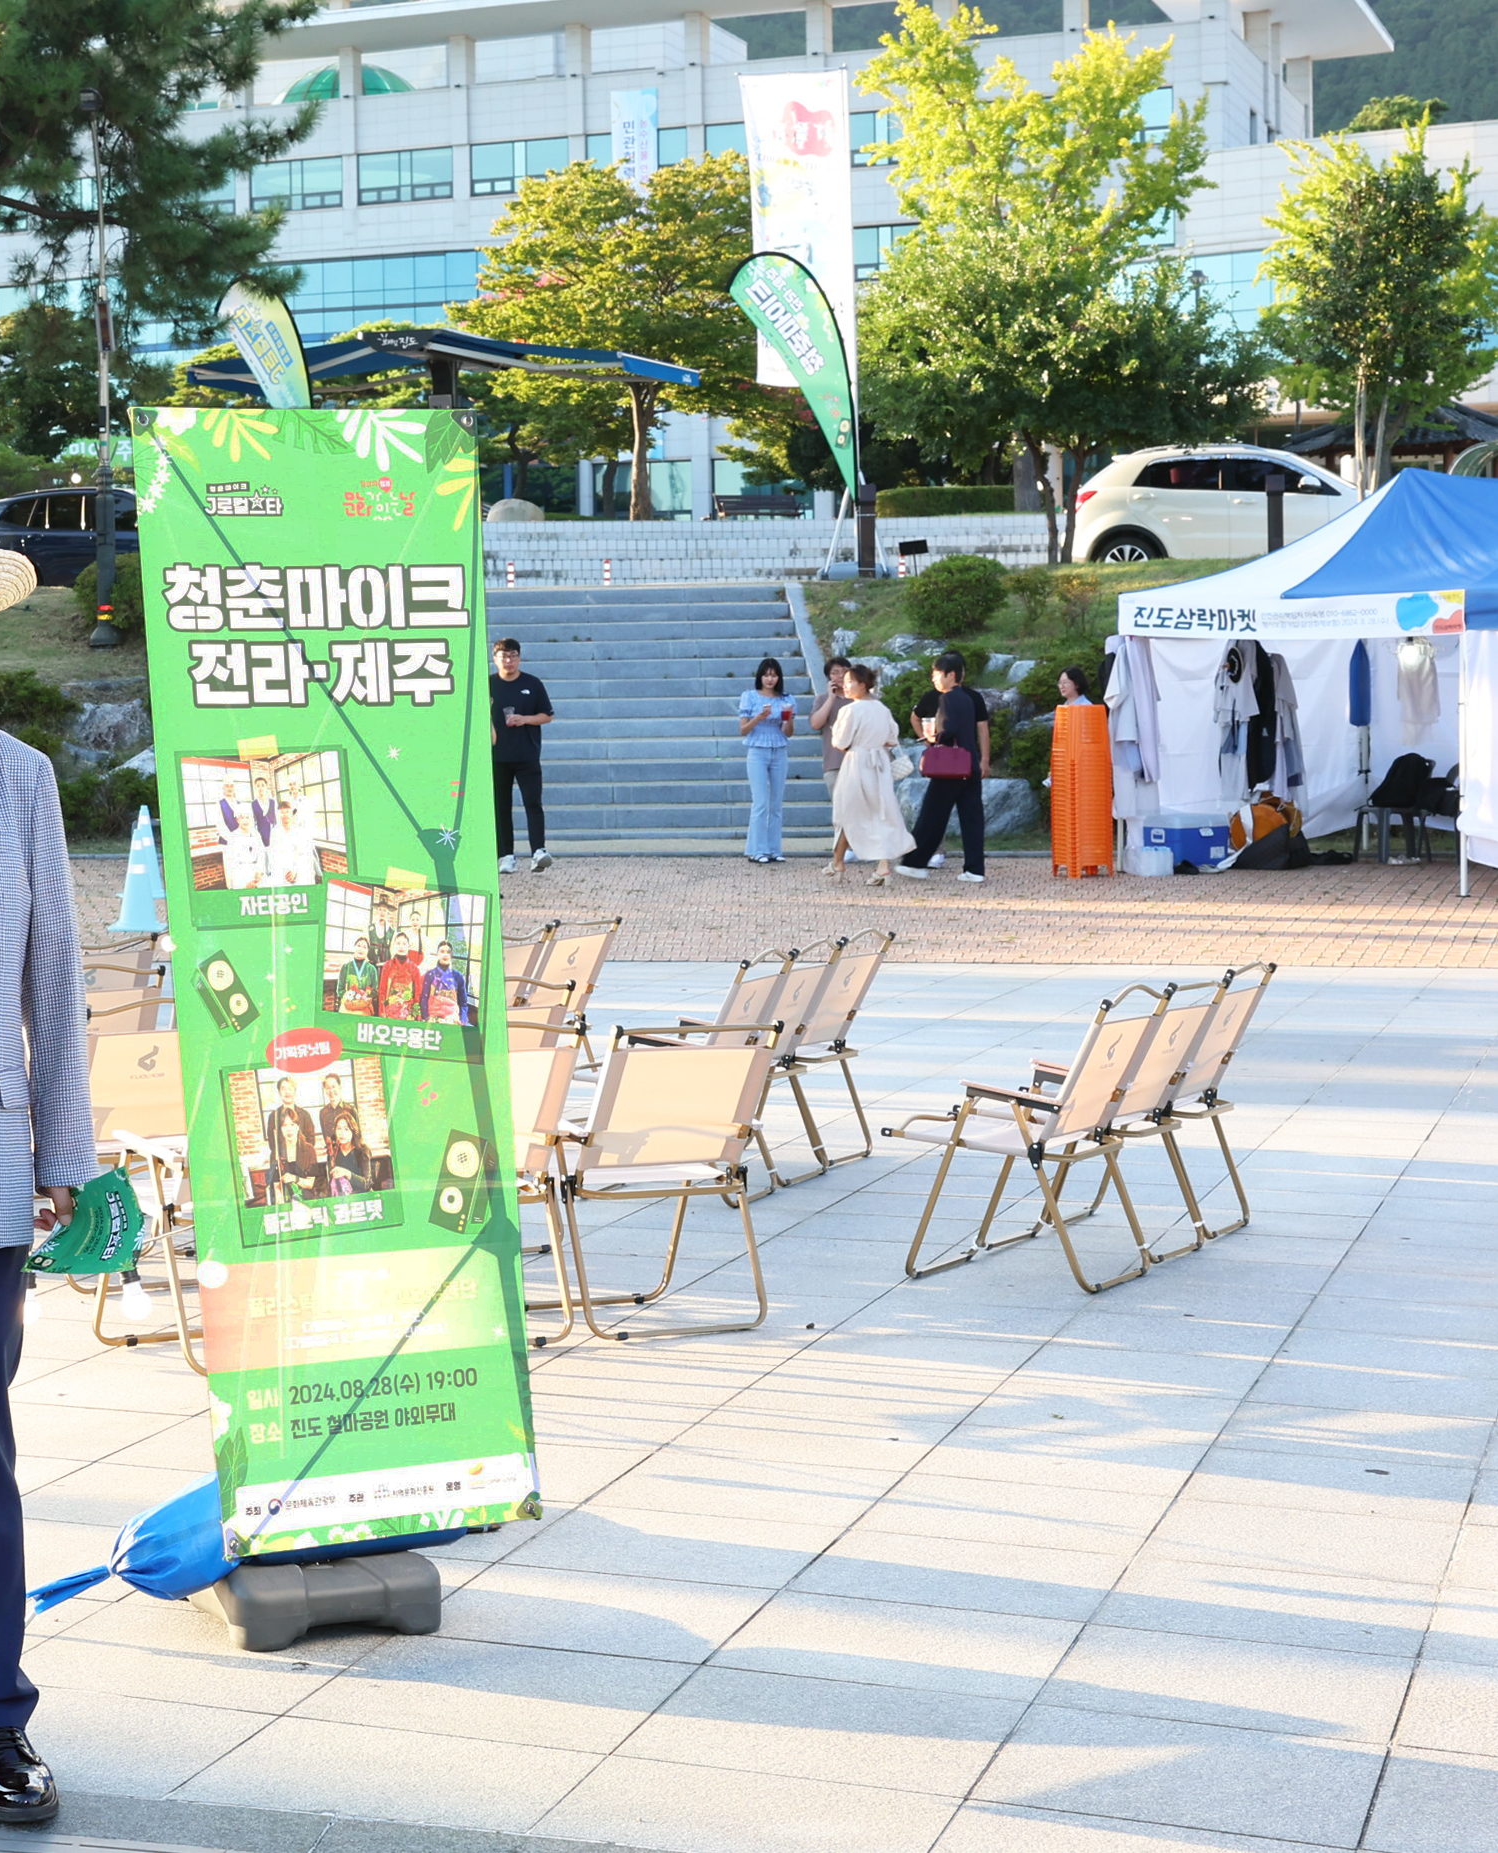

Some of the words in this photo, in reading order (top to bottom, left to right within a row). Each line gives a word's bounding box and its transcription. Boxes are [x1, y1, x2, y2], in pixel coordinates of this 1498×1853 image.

[163, 563, 470, 632] 청춘마이크
[1133, 606, 1258, 632] 진도삼락마켓
[189, 639, 454, 706] 전라·제주
[239, 893, 308, 917] 자타공인
[356, 1022, 443, 1051] 바오무용단
[288, 1372, 421, 1405] 2024.08.28(수)
[425, 1367, 478, 1391] 19:00
[290, 1416, 323, 1440] 진도
[326, 1409, 390, 1436] 철마공원
[394, 1402, 457, 1428] 야외무대
